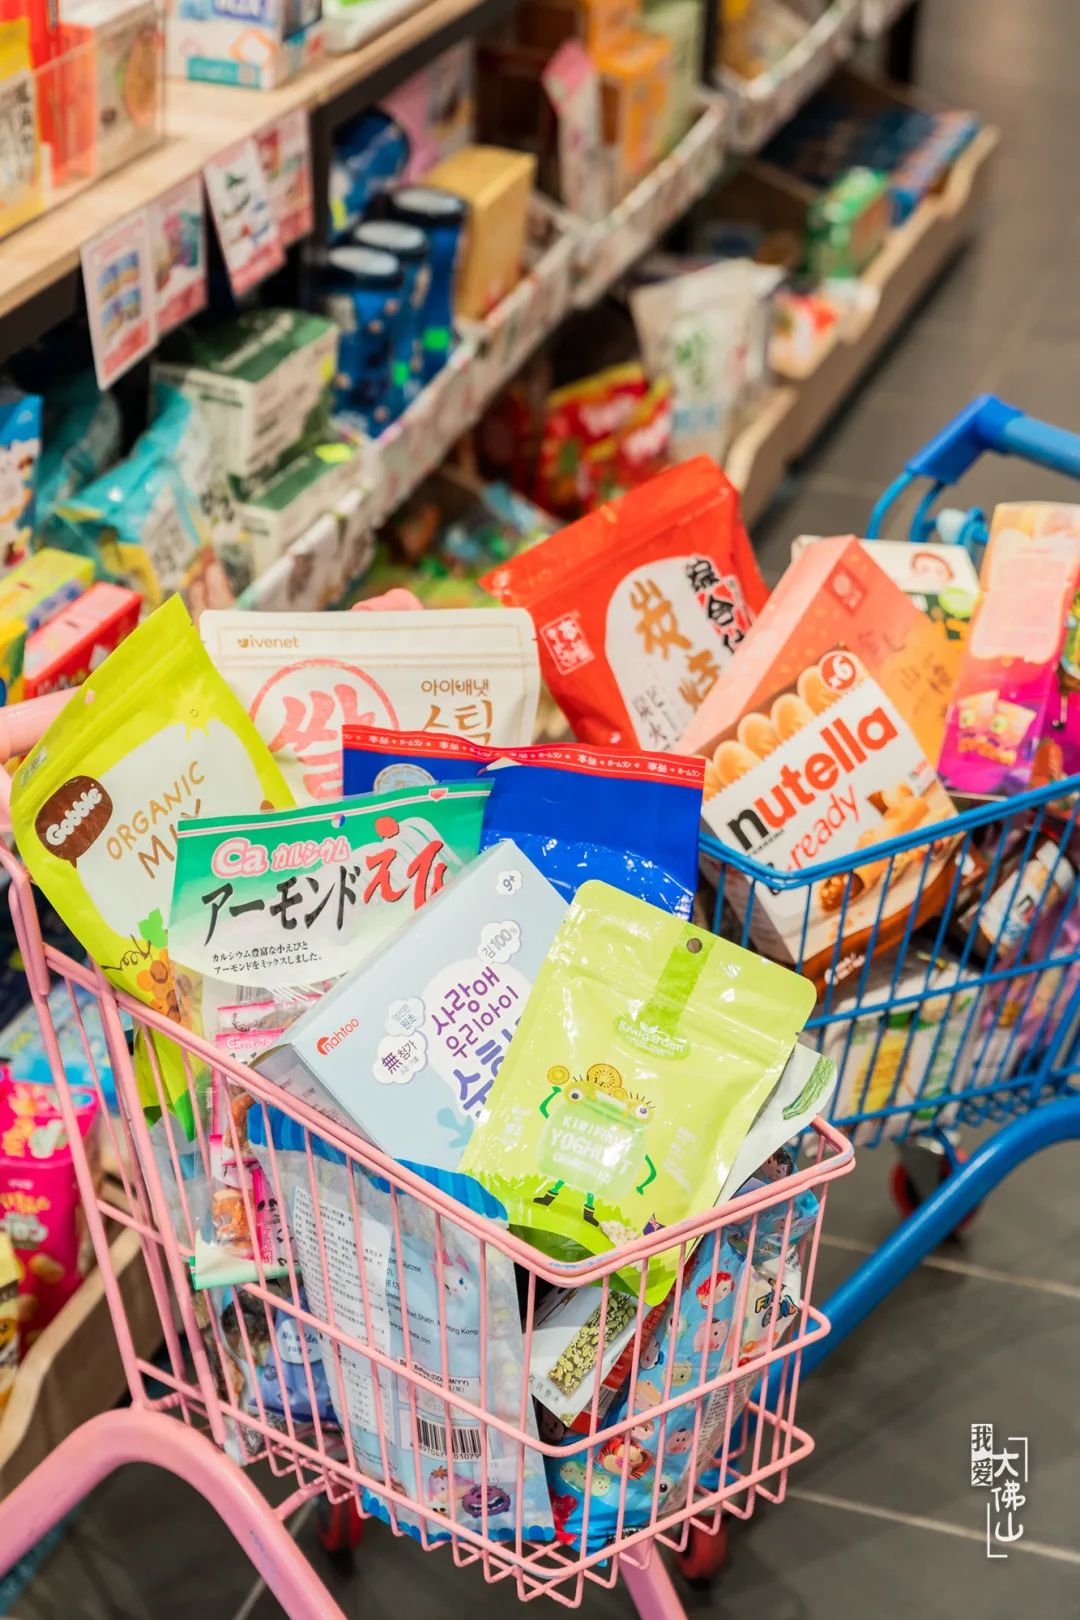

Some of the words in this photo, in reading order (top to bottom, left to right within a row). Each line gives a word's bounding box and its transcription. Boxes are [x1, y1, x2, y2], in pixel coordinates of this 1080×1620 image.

[249, 635, 299, 648] ivenet
[727, 707, 898, 851] nutella
[106, 760, 205, 860] ORGANIC
[211, 837, 269, 878] Ca
[271, 836, 351, 871] カルシウム
[502, 874, 516, 892] 9+
[317, 1018, 359, 1055] nahtoo
[446, 985, 519, 1058] 우리아이
